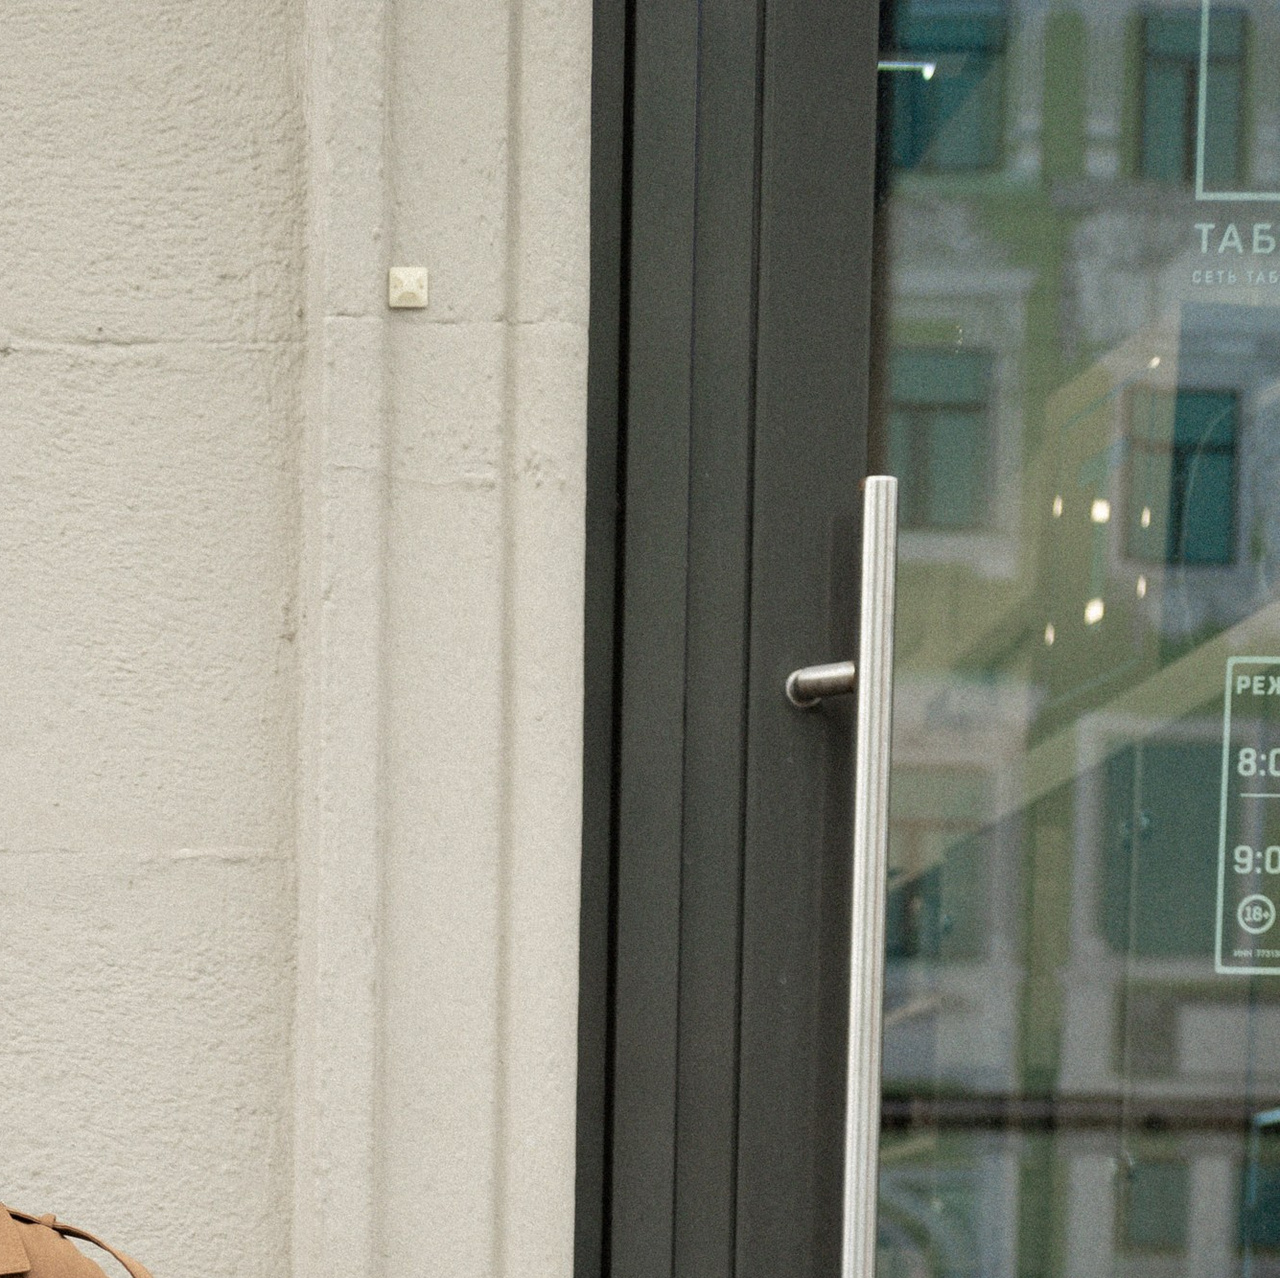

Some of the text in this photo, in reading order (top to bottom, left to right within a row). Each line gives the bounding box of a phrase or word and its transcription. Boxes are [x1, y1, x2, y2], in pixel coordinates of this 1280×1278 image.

[1194, 223, 1276, 254] ТАБ
[1192, 270, 1237, 284] СЕТЬ
[1233, 845, 1280, 874] 9:0
[1244, 905, 1271, 922] 18+
